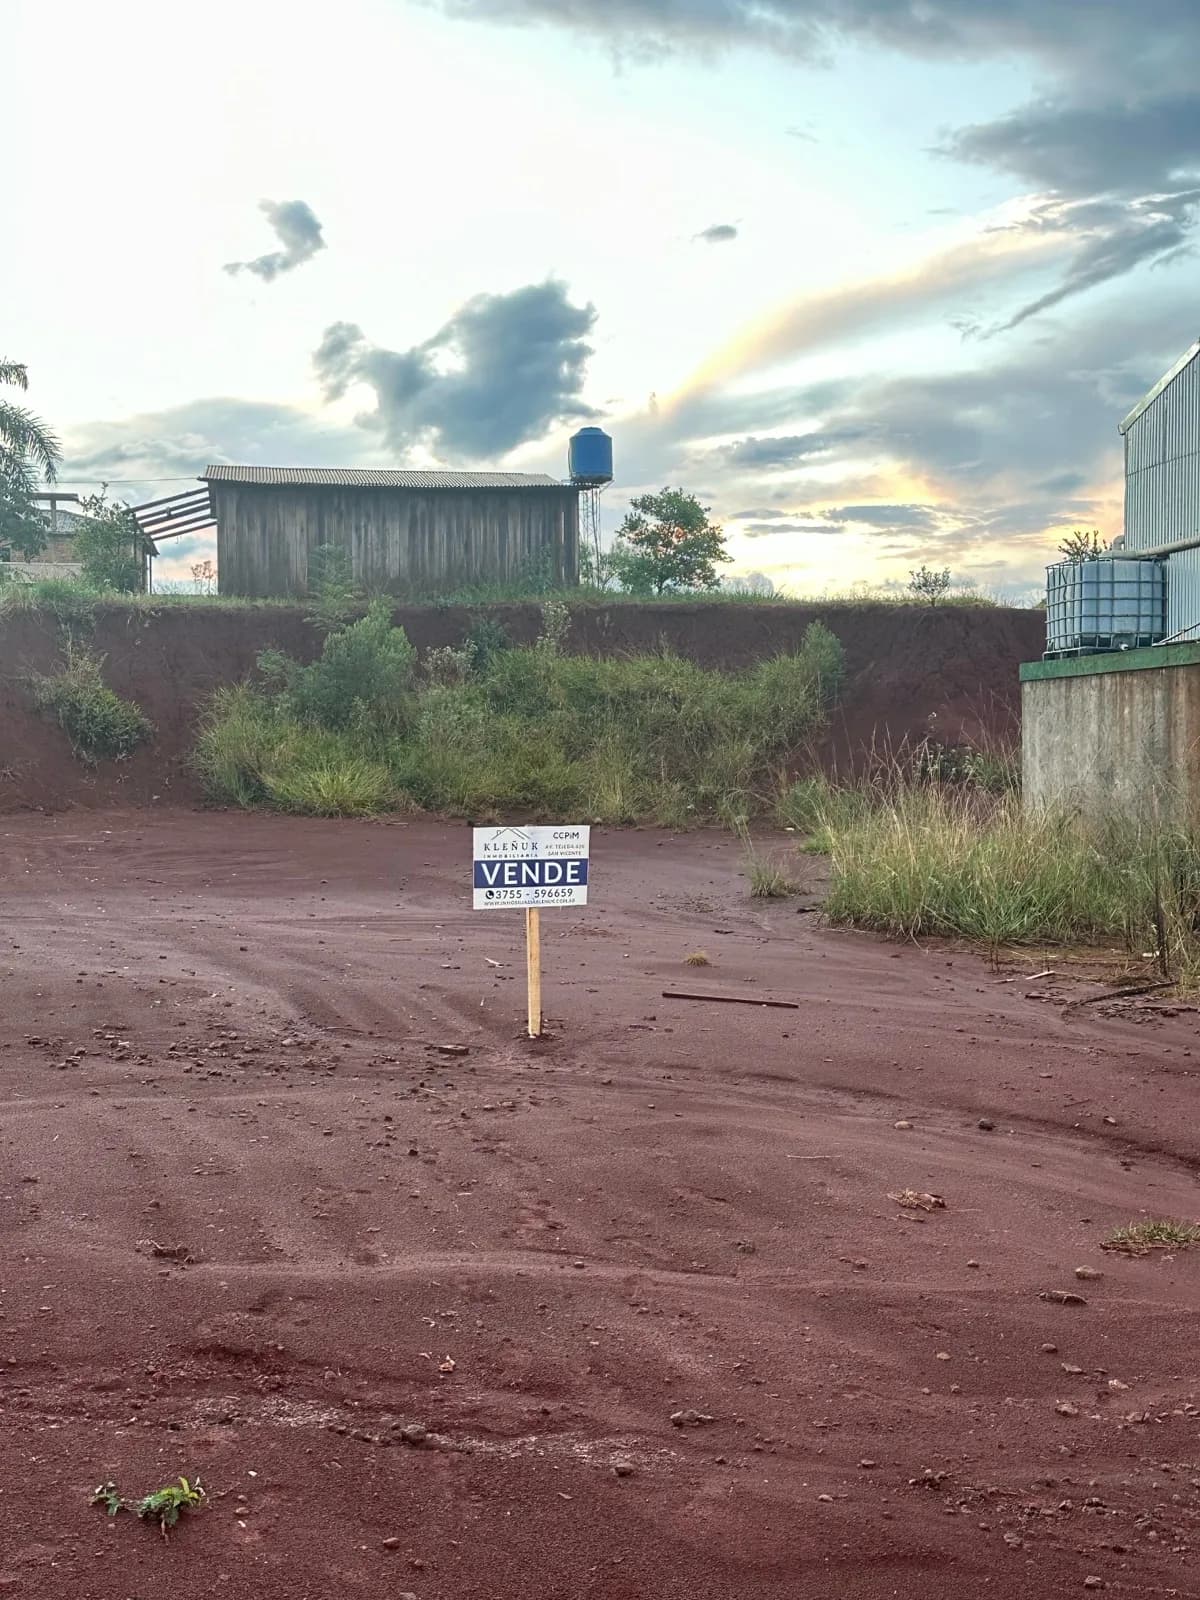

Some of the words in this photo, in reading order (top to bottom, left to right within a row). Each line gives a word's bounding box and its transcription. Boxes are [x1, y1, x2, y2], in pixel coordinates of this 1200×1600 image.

[484, 841, 538, 851] KLEÑUK
[481, 862, 580, 885] VENDE
[496, 890, 522, 899] 3755
[534, 888, 573, 898] 596659
